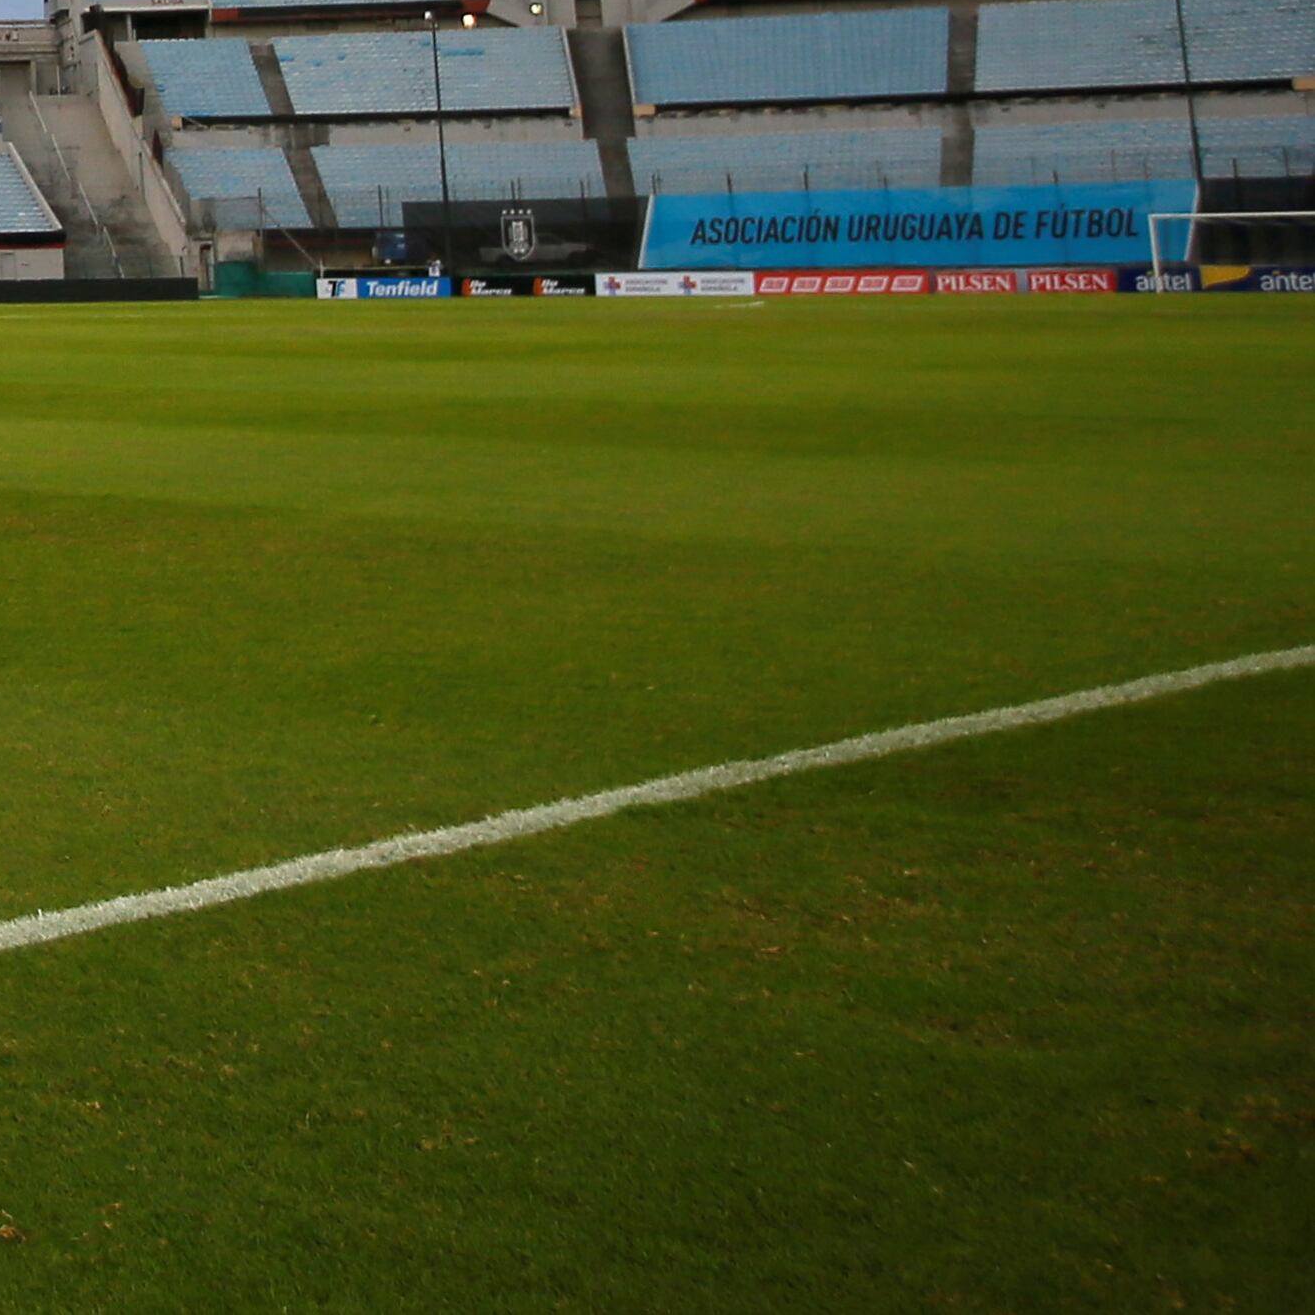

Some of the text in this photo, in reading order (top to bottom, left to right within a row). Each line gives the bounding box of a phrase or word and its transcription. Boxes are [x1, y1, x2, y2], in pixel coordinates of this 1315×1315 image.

[690, 203, 1138, 245] ASOCIACIÓN URUGUAYA DE FÚTBOL
[366, 279, 439, 297] Tenfield
[936, 274, 1011, 292] PILSEN
[1031, 274, 1109, 291] PILSEN
